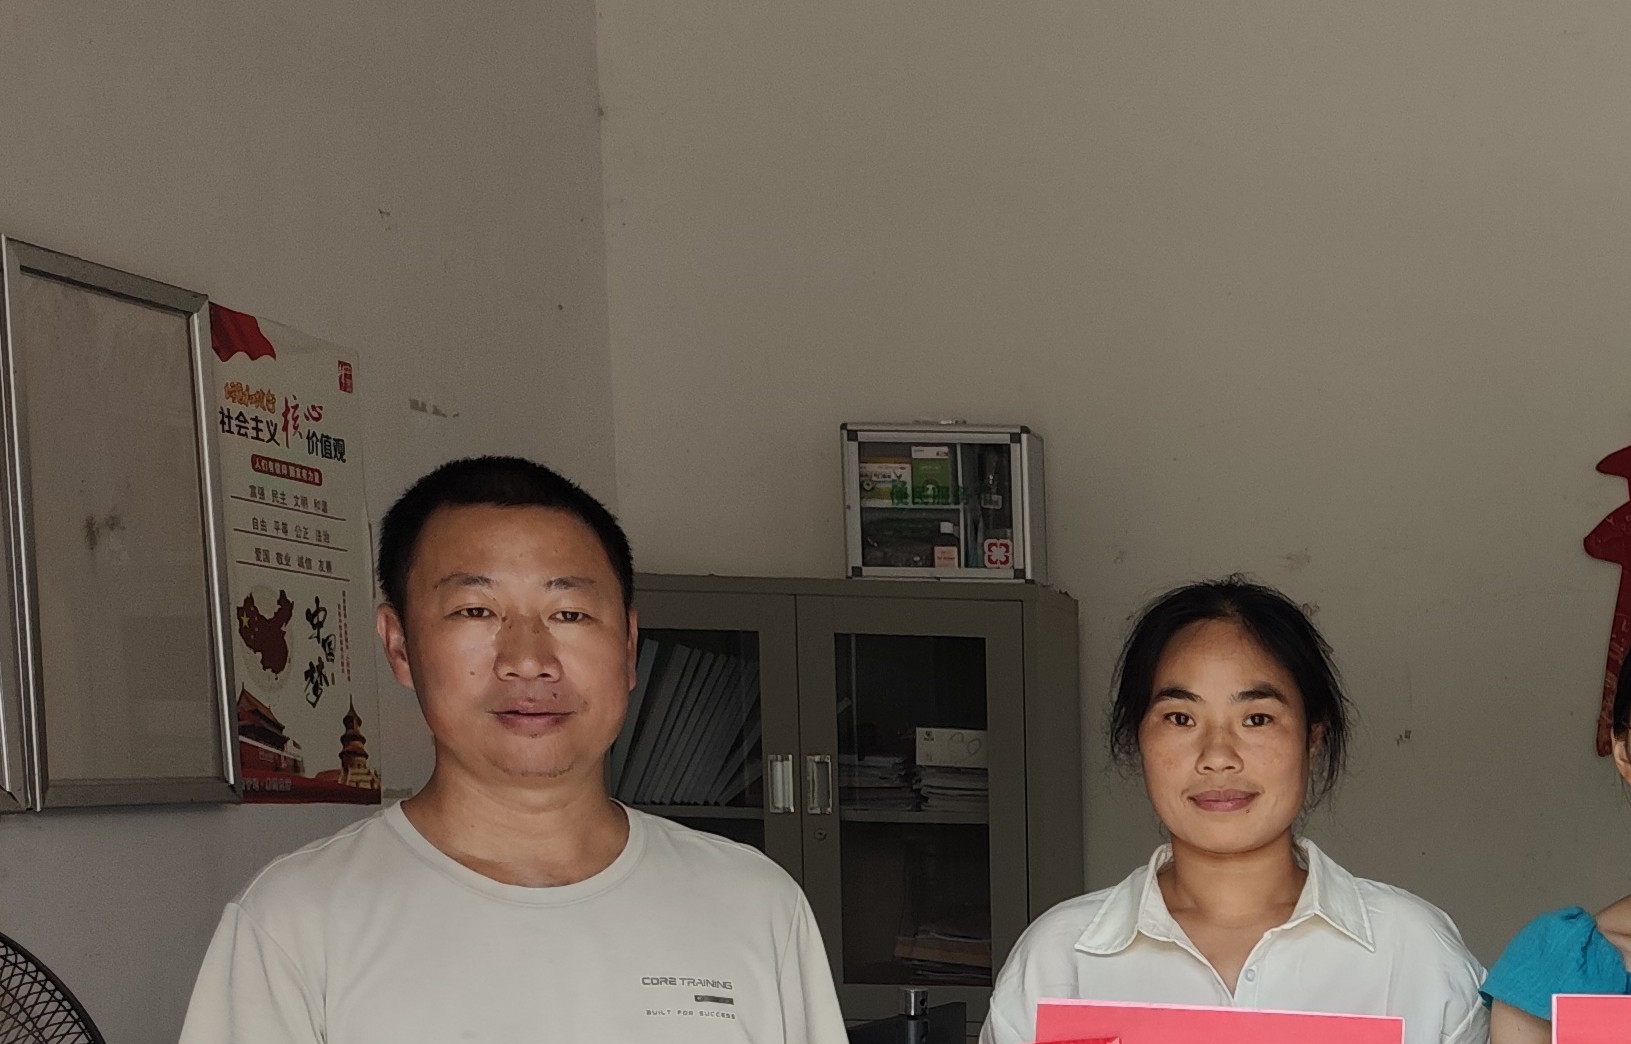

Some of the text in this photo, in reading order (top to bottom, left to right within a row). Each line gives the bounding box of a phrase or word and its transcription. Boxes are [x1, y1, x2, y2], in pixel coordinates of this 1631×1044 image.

[219, 406, 281, 447] 社会主义
[282, 395, 323, 448] 核心
[306, 428, 347, 463] 价值观
[271, 489, 288, 506] 民主
[251, 516, 268, 532] 自由
[254, 547, 271, 563] 爱国
[641, 976, 734, 990] CORE TRAINING
[698, 1010, 736, 1020] SUCCESS
